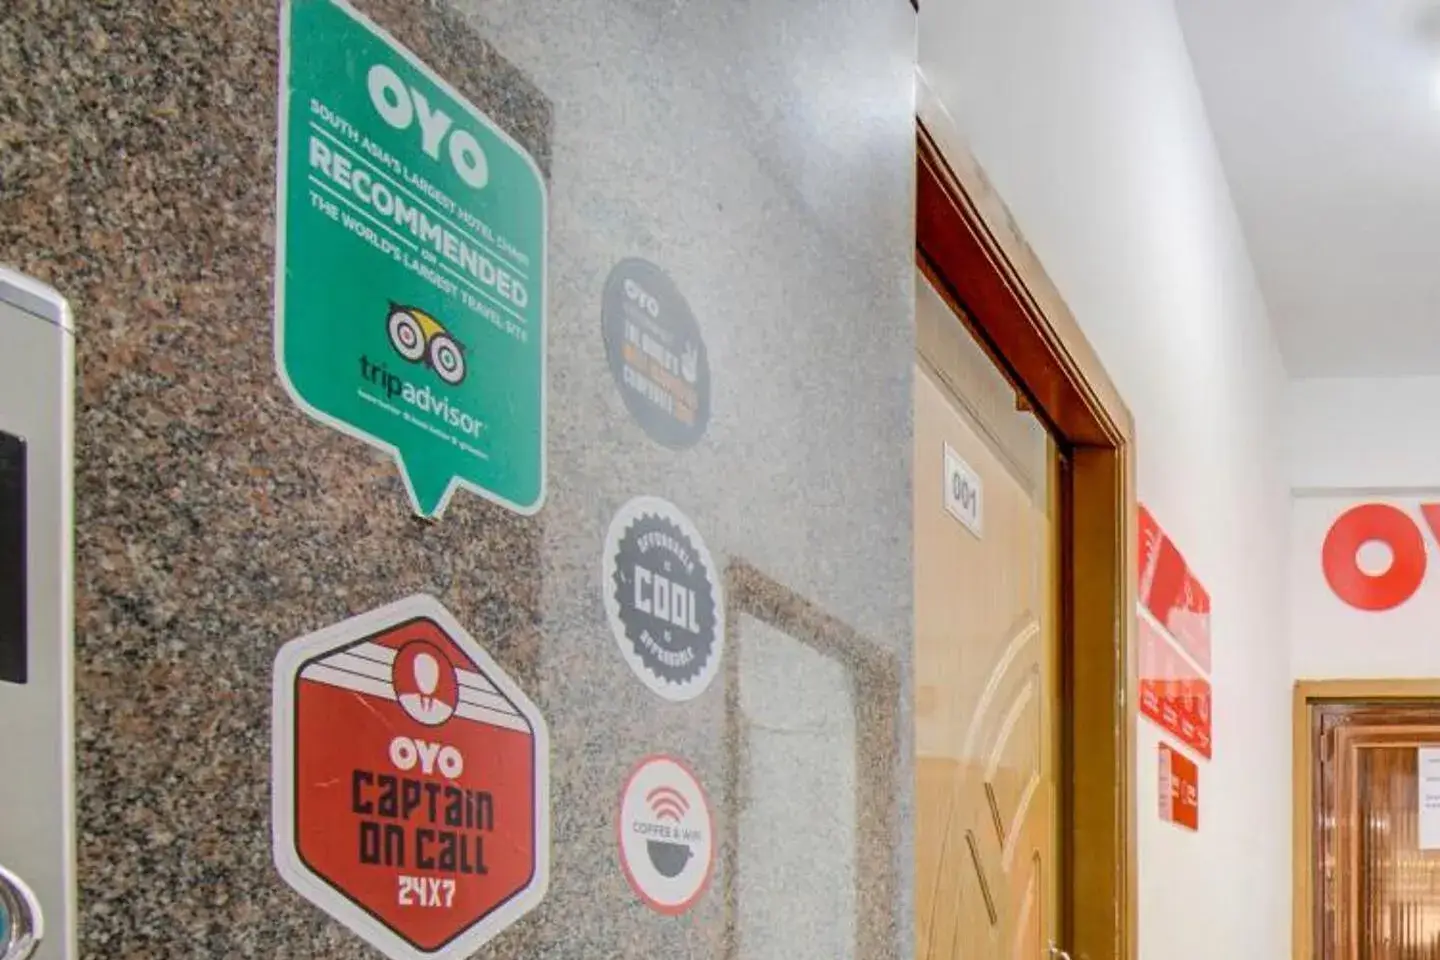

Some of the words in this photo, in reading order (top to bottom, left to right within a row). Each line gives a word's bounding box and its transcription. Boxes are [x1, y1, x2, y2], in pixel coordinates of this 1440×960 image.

[309, 97, 359, 143] SOUTH
[367, 63, 489, 189] OYO
[309, 135, 528, 308] RECOMMENDED
[309, 188, 340, 221] THE
[341, 211, 402, 262] WORLD'S
[623, 278, 660, 318] OYO
[358, 353, 483, 439] tripadvisor
[953, 470, 977, 519] 001
[634, 564, 700, 635] COOL
[389, 735, 464, 779] OYO
[632, 821, 671, 838] COFFEE
